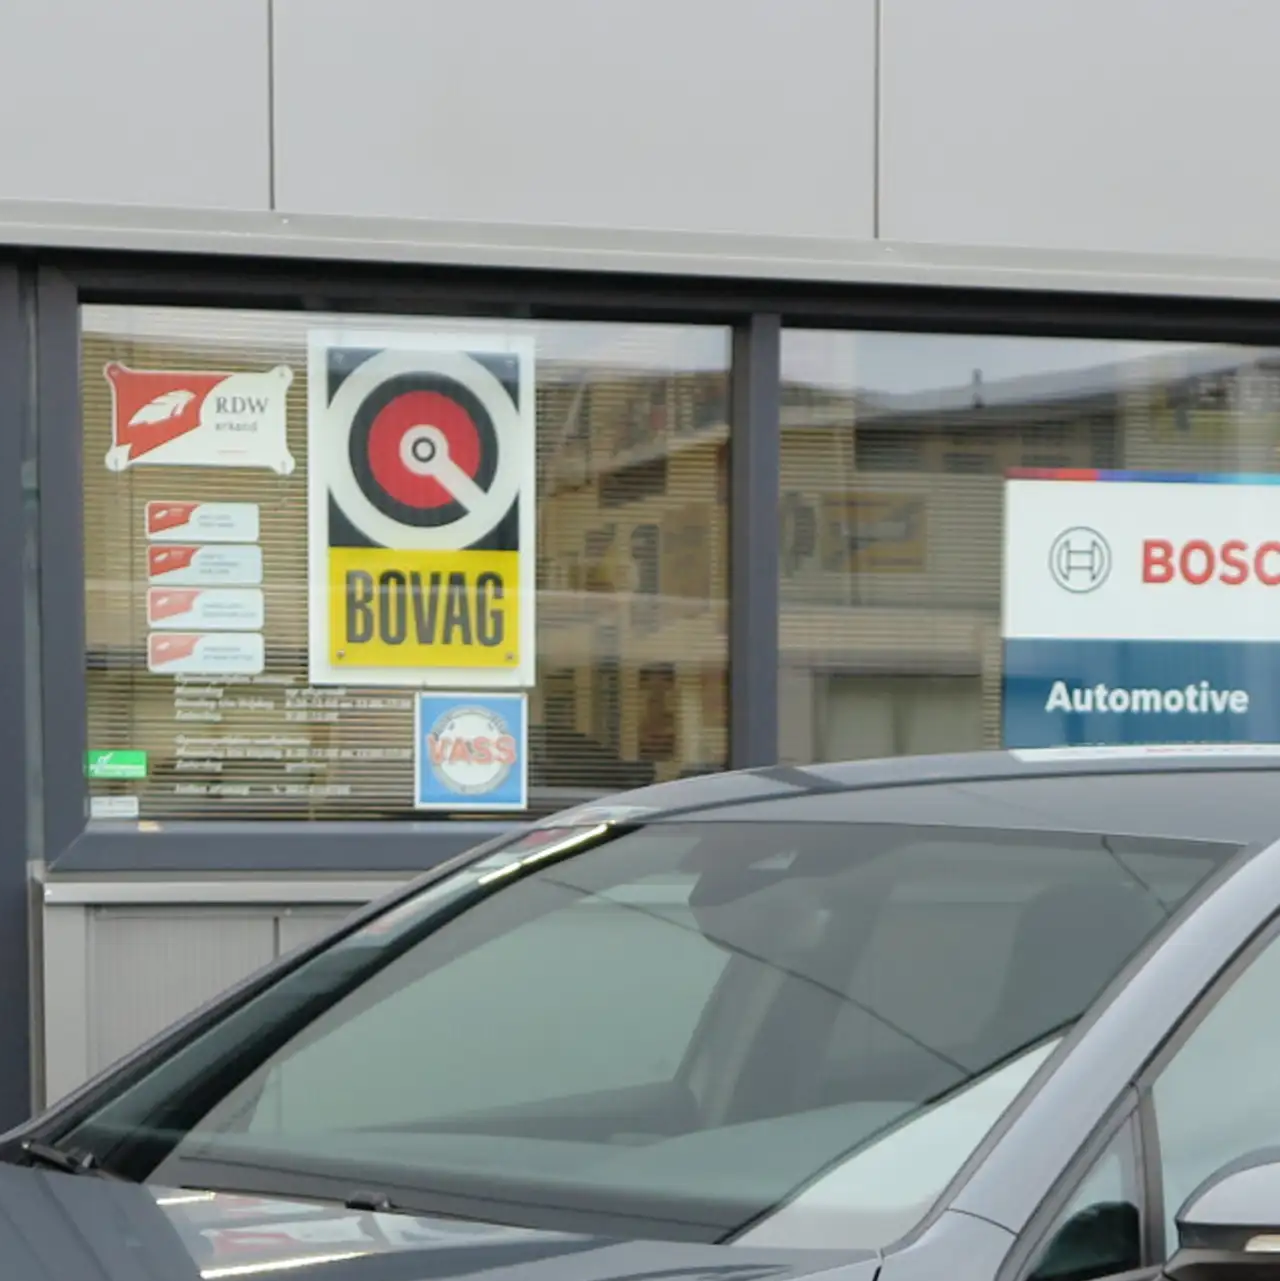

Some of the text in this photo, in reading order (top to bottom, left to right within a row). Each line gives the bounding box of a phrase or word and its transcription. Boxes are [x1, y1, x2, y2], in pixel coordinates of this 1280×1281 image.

[216, 395, 270, 414] RDW
[346, 569, 505, 647] BOVAG
[1045, 680, 1250, 713] Automotive
